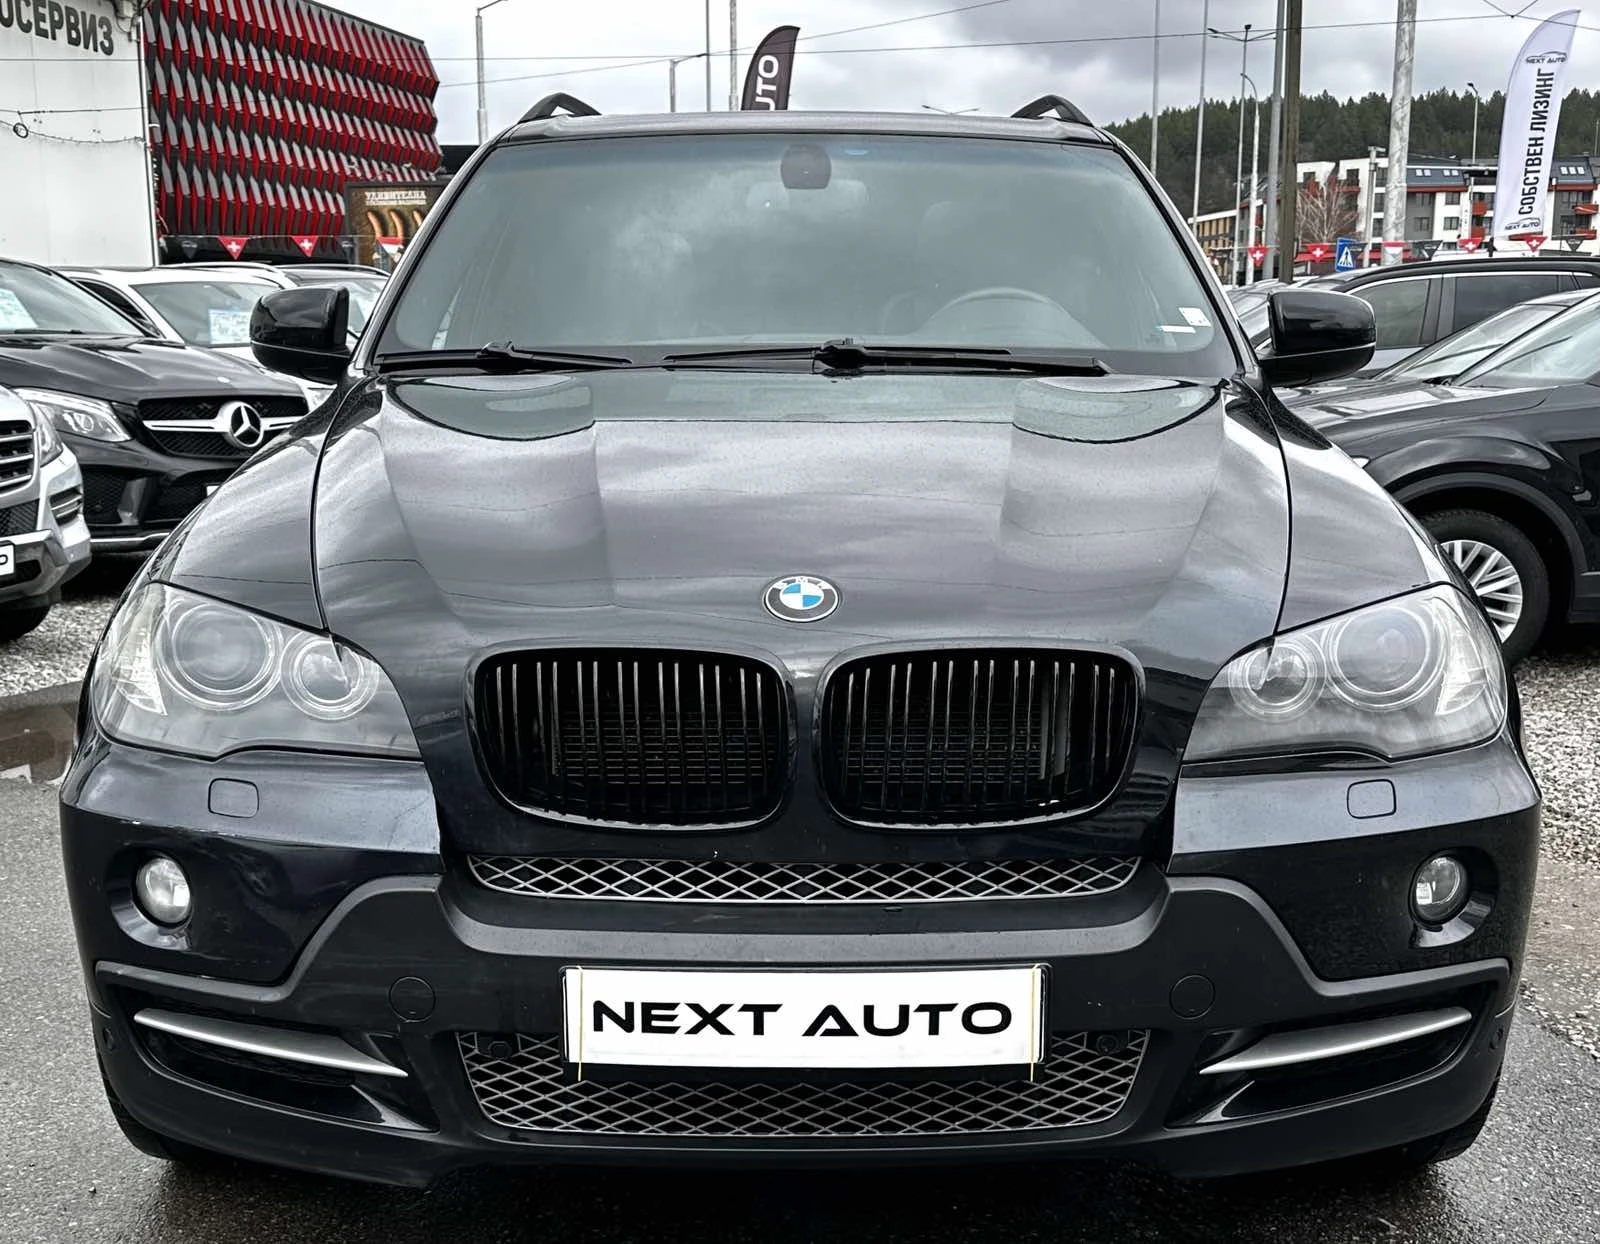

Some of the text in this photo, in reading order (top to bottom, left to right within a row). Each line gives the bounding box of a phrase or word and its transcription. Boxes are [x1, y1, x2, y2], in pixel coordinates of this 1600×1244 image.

[1518, 68, 1555, 215] СОБСТВЕН ЛИЗИНГ
[1521, 221, 1540, 229] AUTO
[592, 1000, 1013, 1037] NEXT AUTO
